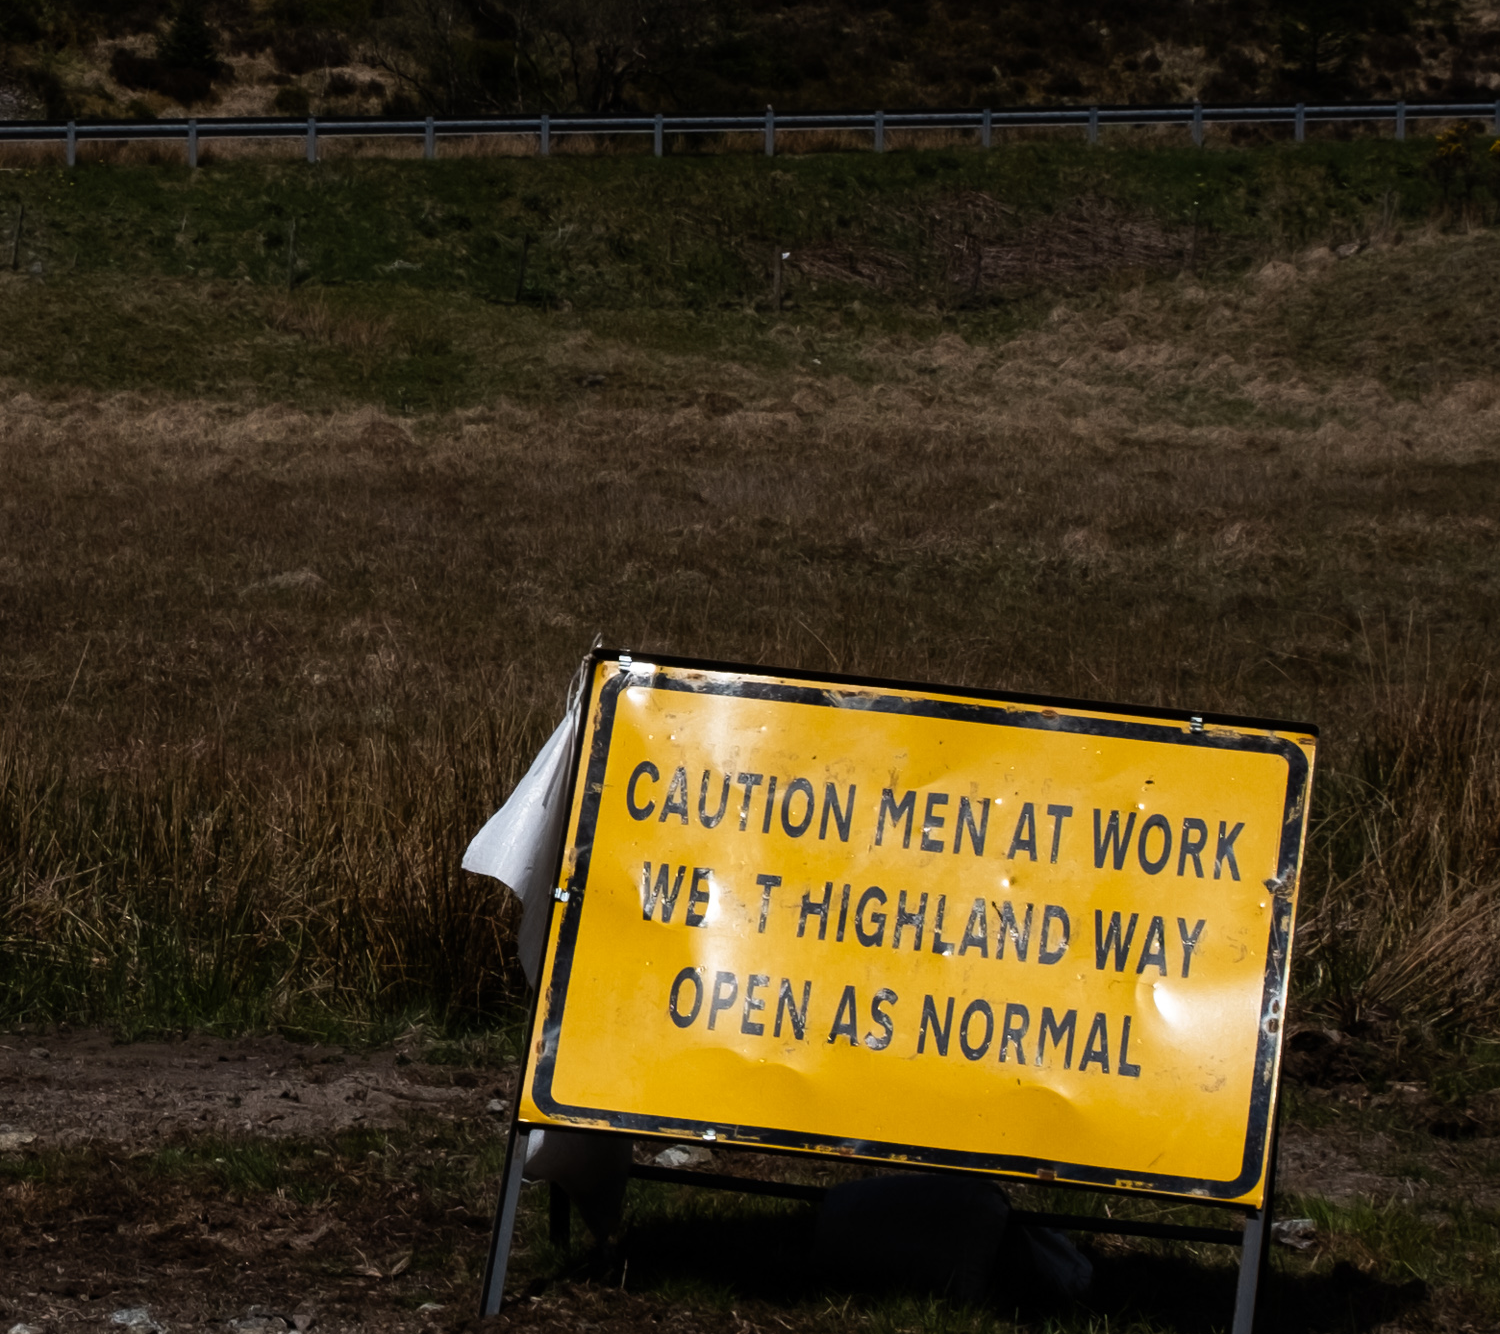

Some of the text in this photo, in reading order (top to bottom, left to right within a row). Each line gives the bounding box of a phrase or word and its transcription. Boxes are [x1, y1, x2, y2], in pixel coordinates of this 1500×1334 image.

[626, 760, 1245, 881] CAUTION MEN AT WORK
[642, 861, 1206, 978] WET HIGHLAND WAY
[669, 966, 1141, 1078] OPEN AS NORMAL
